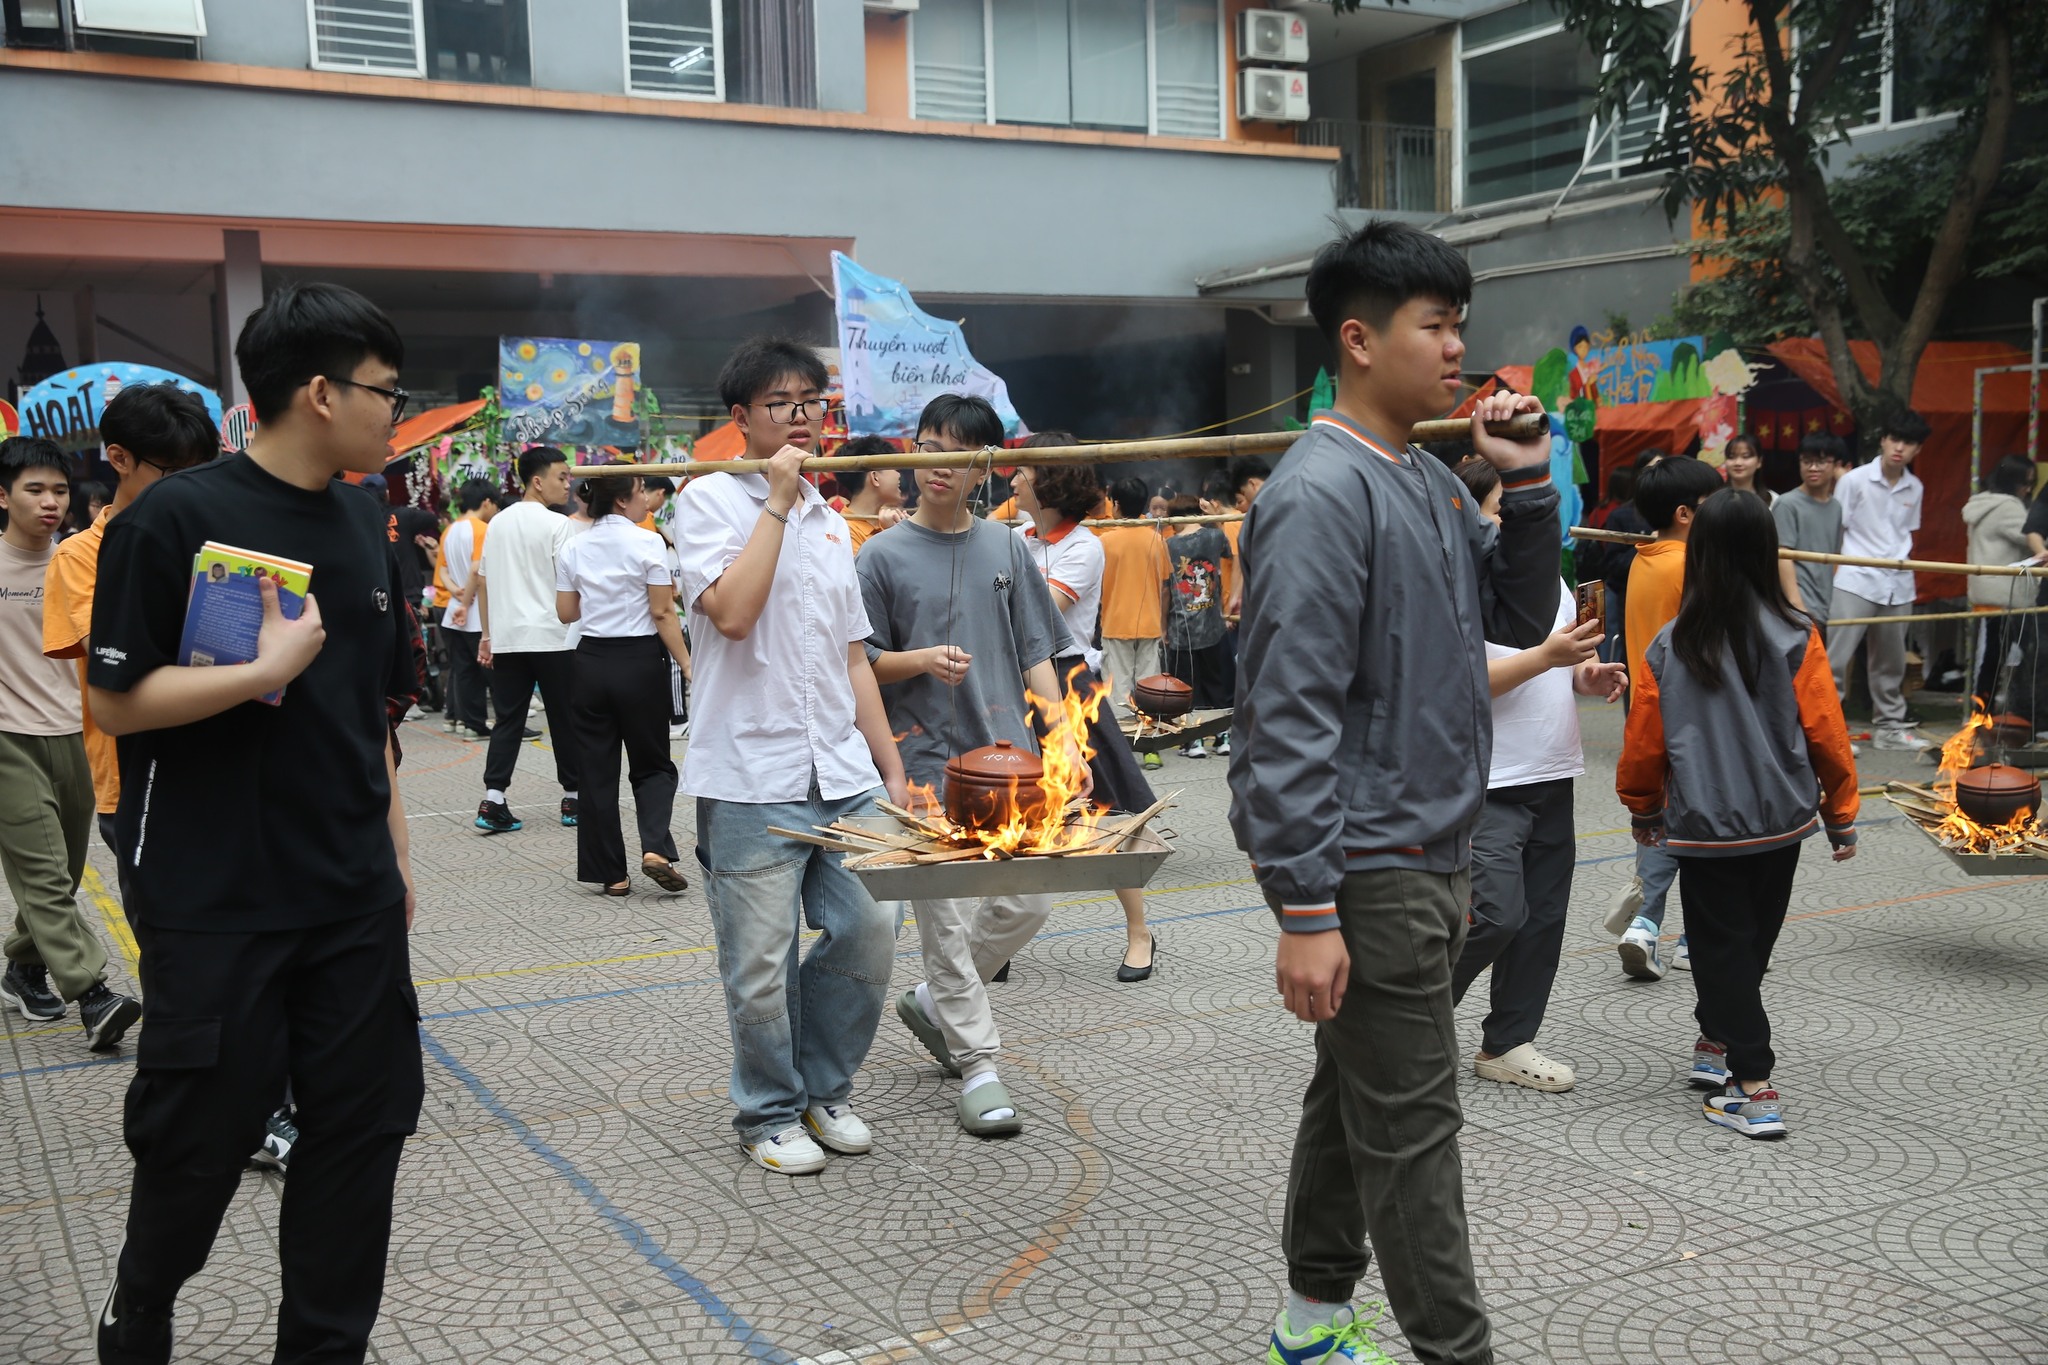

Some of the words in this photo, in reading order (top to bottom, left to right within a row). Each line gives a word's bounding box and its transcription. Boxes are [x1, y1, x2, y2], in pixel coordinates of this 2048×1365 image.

[912, 336, 949, 359] vượt
[931, 363, 968, 386] khơi
[96, 647, 128, 661] LIFEWORK
